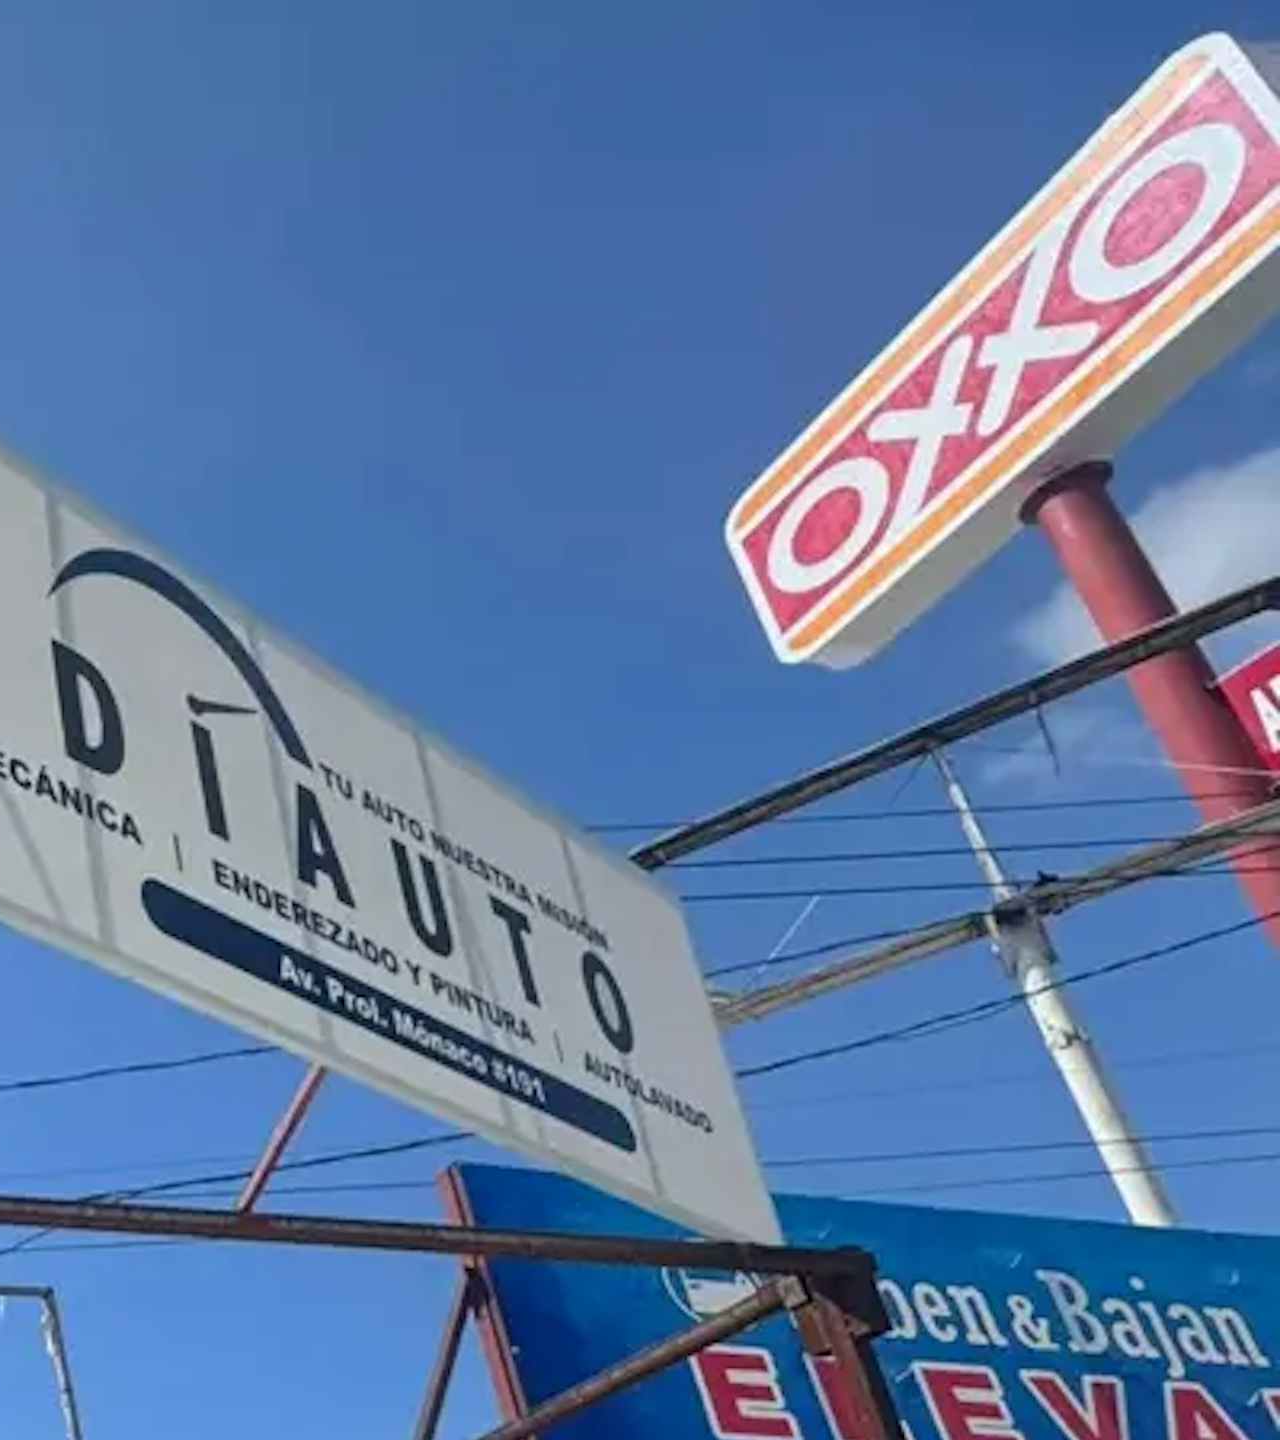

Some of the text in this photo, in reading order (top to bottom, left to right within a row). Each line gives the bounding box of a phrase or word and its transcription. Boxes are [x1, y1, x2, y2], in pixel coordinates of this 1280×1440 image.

[766, 122, 1246, 594] OXXO
[319, 762, 354, 800] TU
[362, 789, 425, 843] AUTO
[430, 831, 535, 908] NUESTRA
[212, 858, 400, 974] ENDEREZADO
[405, 960, 423, 986] Y
[430, 974, 536, 1045] PINTURA
[583, 1050, 715, 1135] AUTOLAVADO
[278, 955, 321, 995] Av.
[326, 981, 390, 1030] Prol.
[392, 1013, 489, 1077] Mónaco
